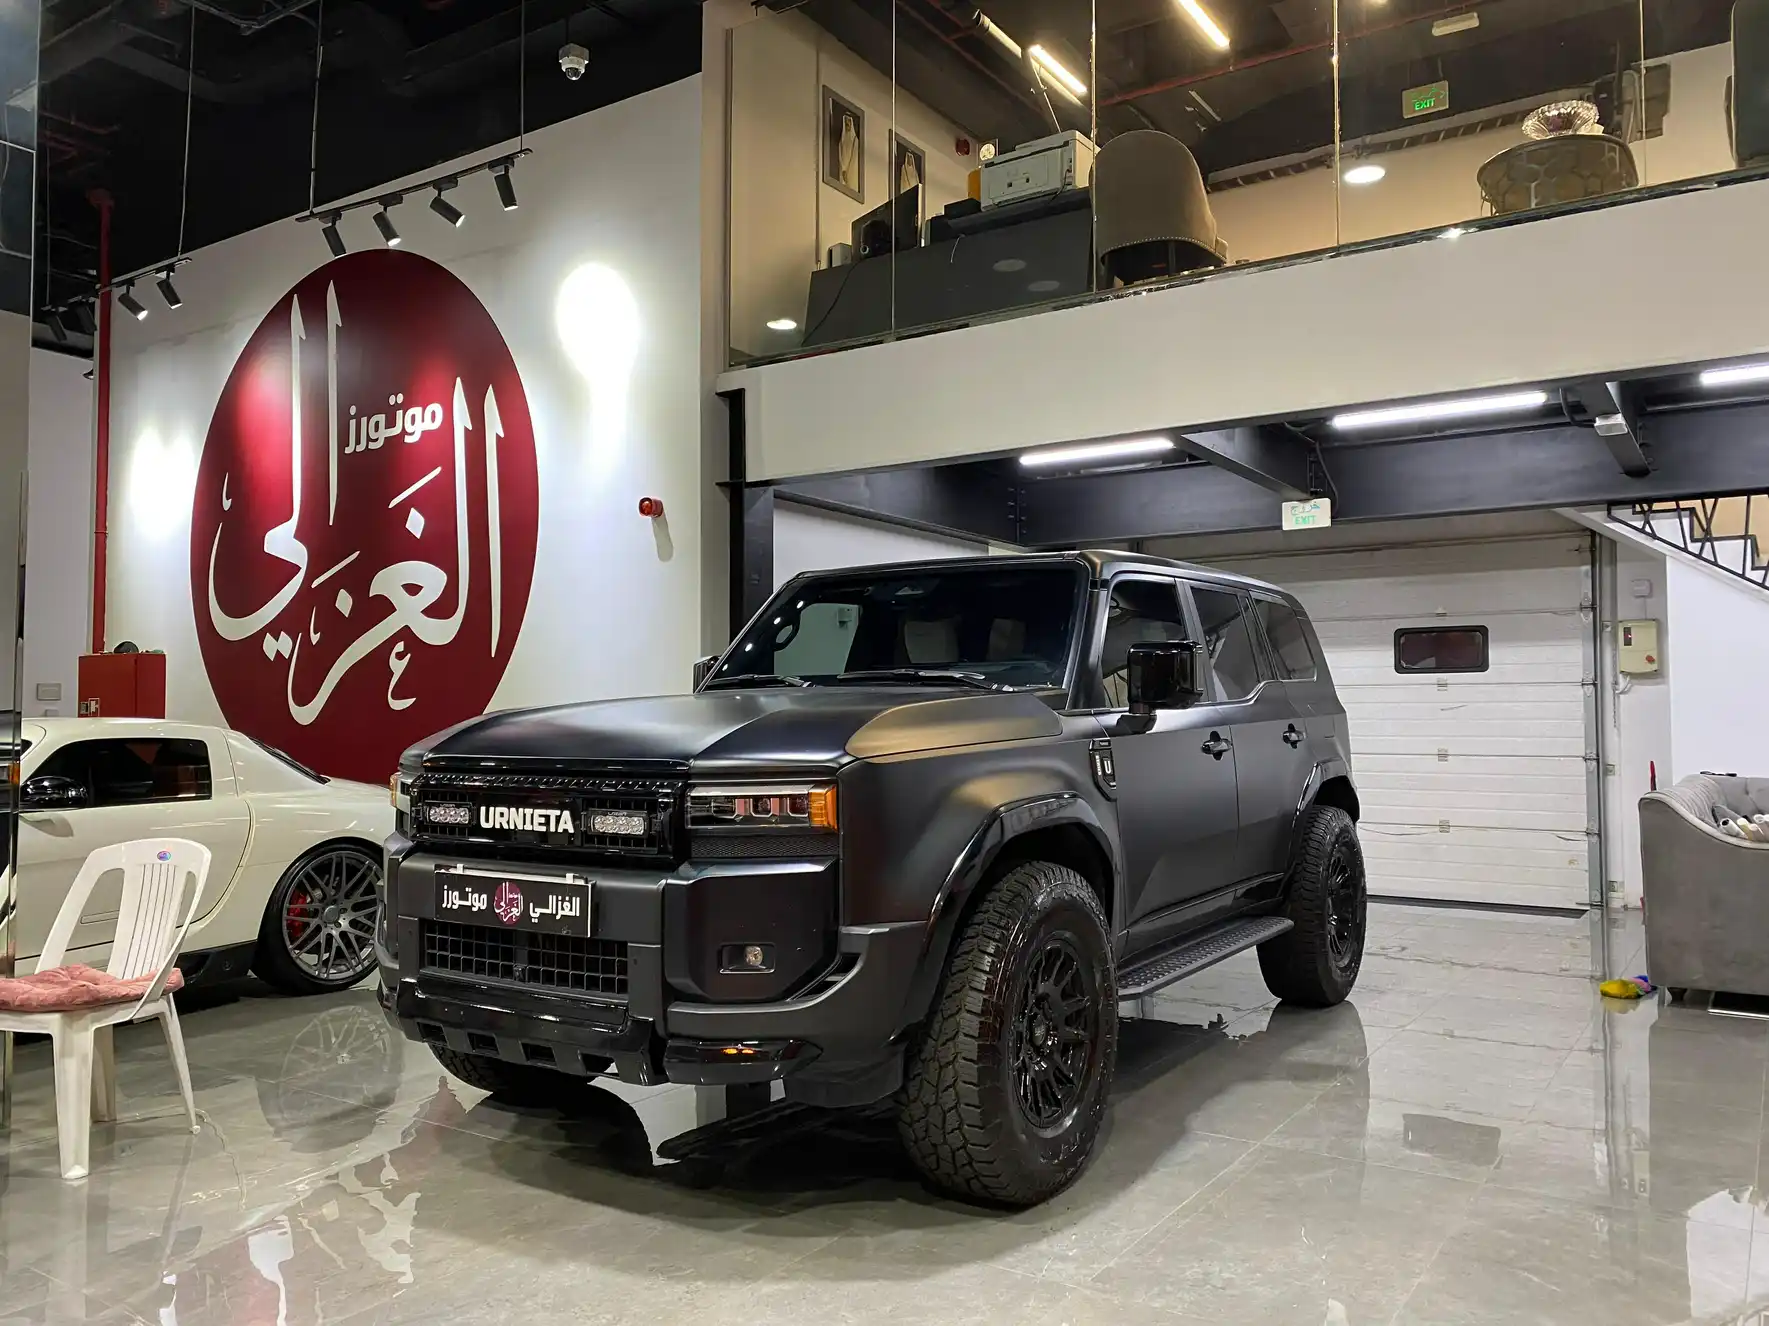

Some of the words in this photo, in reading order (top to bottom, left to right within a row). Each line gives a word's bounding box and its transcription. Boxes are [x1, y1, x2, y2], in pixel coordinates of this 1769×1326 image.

[1414, 98, 1435, 110] EXIT
[344, 392, 443, 454] موتورز
[1295, 514, 1317, 525] EXIT
[479, 806, 575, 834] URNIETA
[441, 884, 488, 912] موتورز
[529, 894, 581, 923] الغزالي
